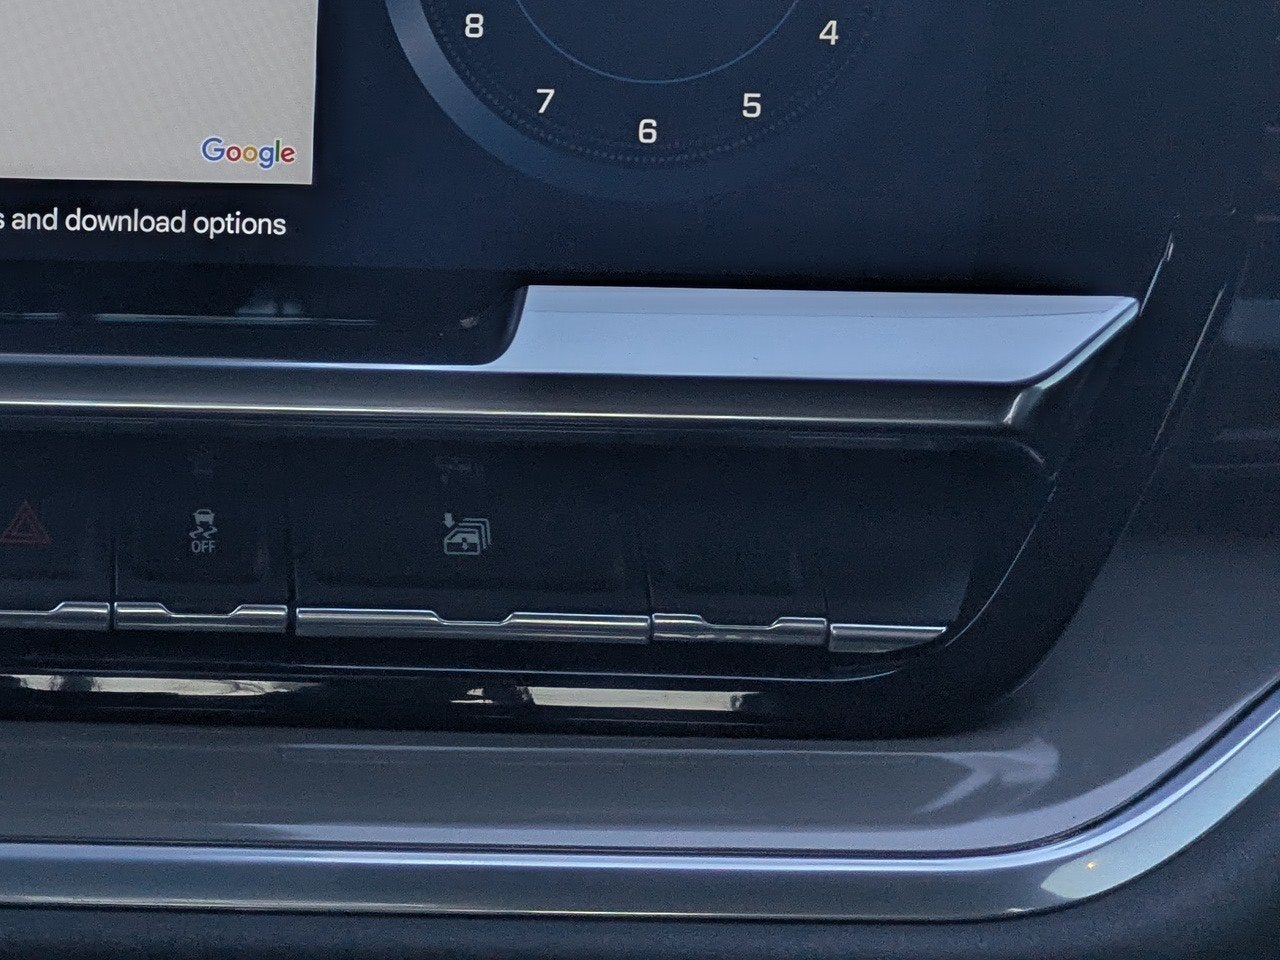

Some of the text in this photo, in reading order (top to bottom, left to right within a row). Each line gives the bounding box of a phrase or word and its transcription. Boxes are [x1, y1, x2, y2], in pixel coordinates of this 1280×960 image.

[464, 13, 484, 39] 8
[818, 20, 839, 46] 4
[536, 88, 555, 114] 7
[742, 92, 762, 118] 5
[638, 118, 658, 144] 6
[201, 137, 295, 169] Google
[11, 206, 59, 231] and
[64, 207, 187, 234] download
[193, 210, 287, 240] options
[191, 539, 216, 553] OFF
